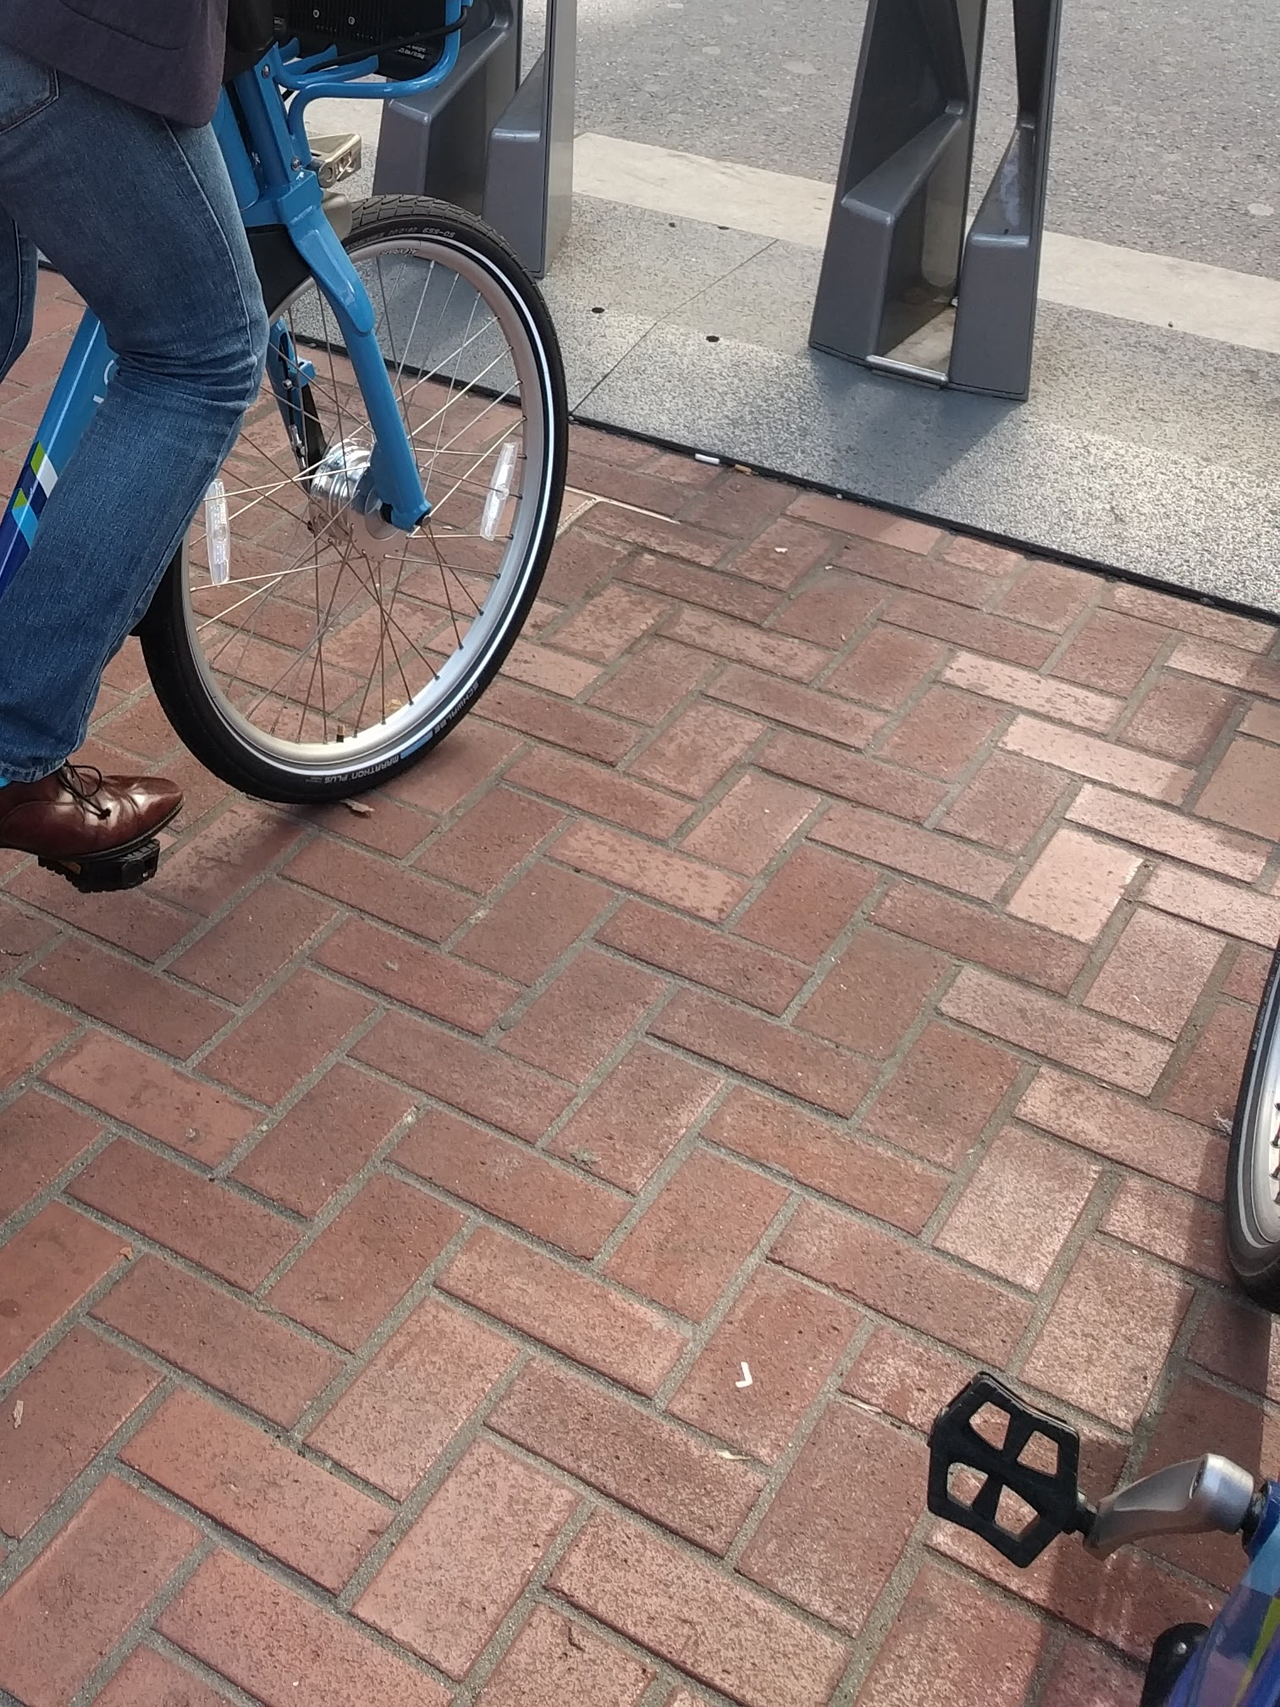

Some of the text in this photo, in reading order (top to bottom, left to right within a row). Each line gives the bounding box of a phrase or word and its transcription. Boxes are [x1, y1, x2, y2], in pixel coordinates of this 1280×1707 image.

[324, 680, 479, 784] SCHWALBE MARATHON PLUS
